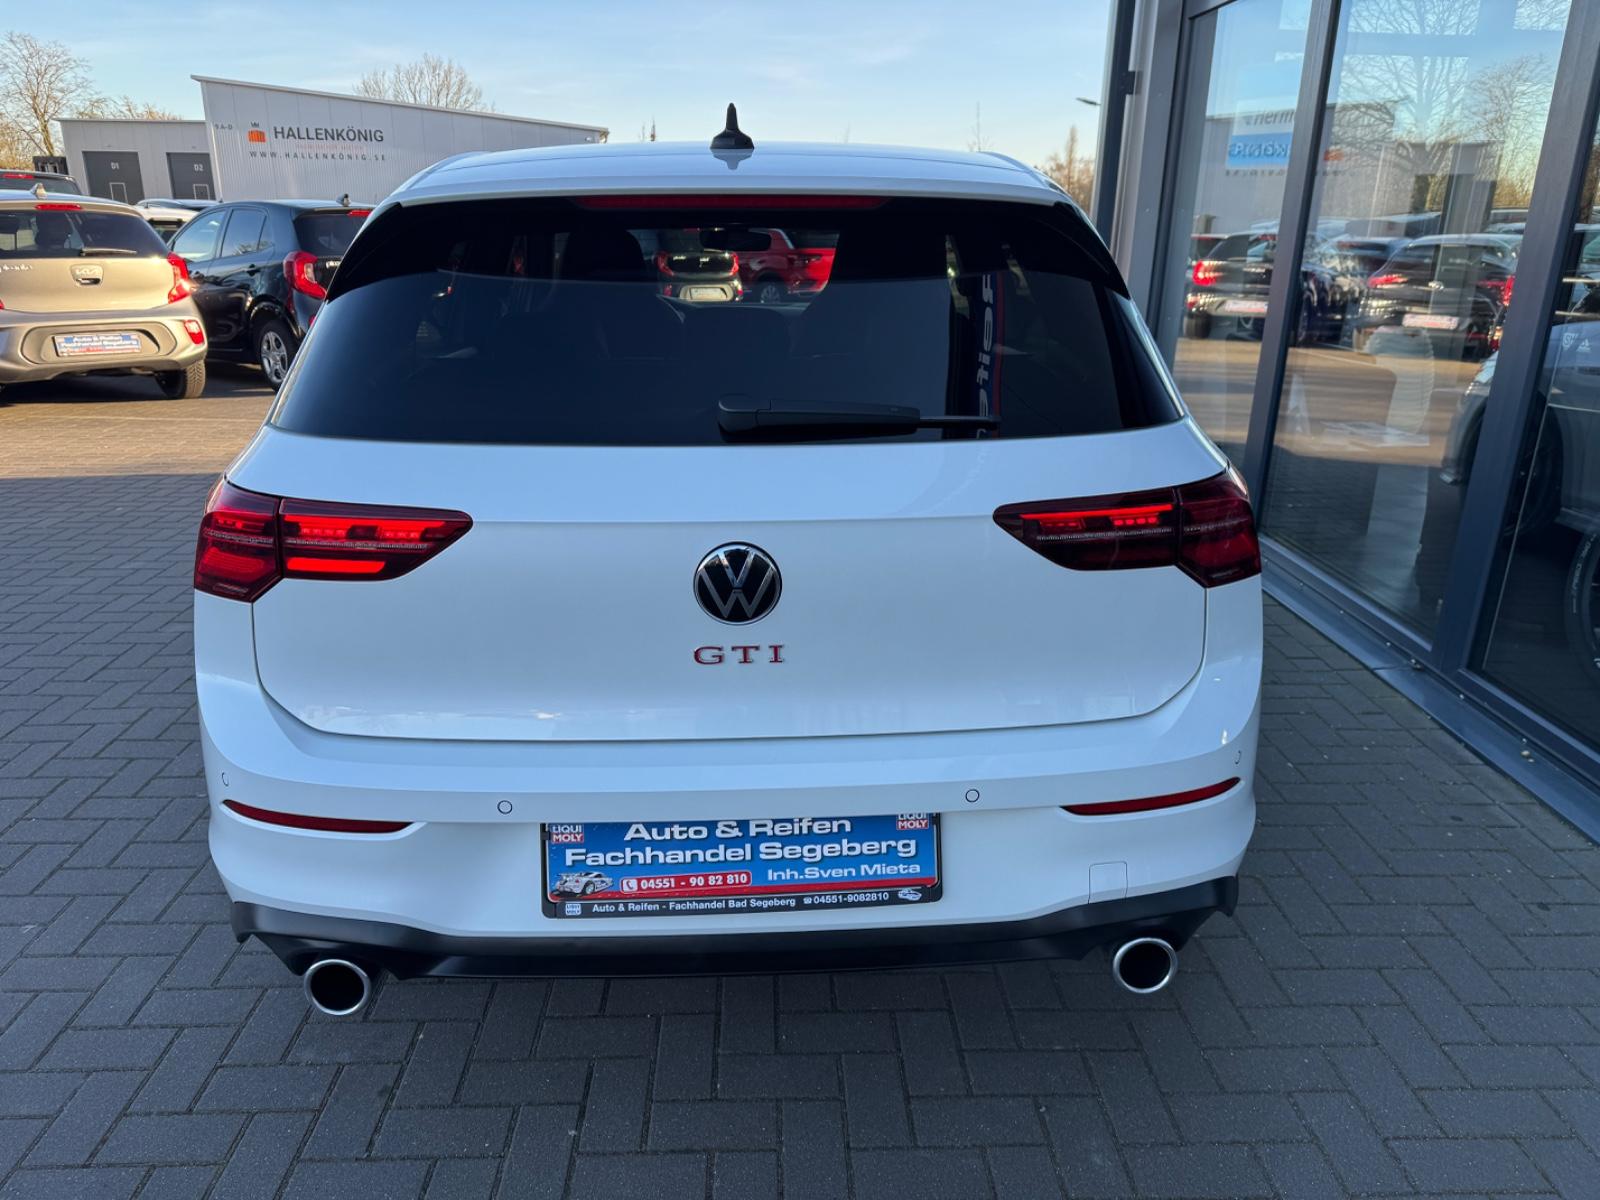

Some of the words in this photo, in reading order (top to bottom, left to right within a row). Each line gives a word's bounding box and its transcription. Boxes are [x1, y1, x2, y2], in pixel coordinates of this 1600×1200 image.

[273, 125, 384, 143] HALLENKÖNIG
[249, 150, 386, 162] WWW.HALLENKÖNIG.SE
[693, 644, 785, 665] GTI
[551, 824, 583, 834] LIQUI
[623, 823, 708, 842] Auto
[715, 820, 743, 838] &
[749, 818, 852, 837] Reifen
[898, 819, 928, 830] MOLY
[552, 833, 584, 843] MOLY
[565, 843, 752, 867] Fachhandel
[759, 838, 916, 863] Segeberg
[767, 867, 856, 882] Inh.Sven
[860, 863, 921, 877] Mieta
[640, 878, 675, 891] 04551
[689, 876, 704, 888] 90
[708, 875, 723, 886] 82
[726, 874, 747, 884] 810
[592, 903, 615, 913] Auto
[618, 903, 625, 912] &
[628, 902, 660, 912] Reifen
[669, 899, 726, 911] Fachhandel
[728, 898, 748, 909] Bad
[749, 897, 796, 909] Segeberg
[813, 891, 889, 905] 04551-9082810
